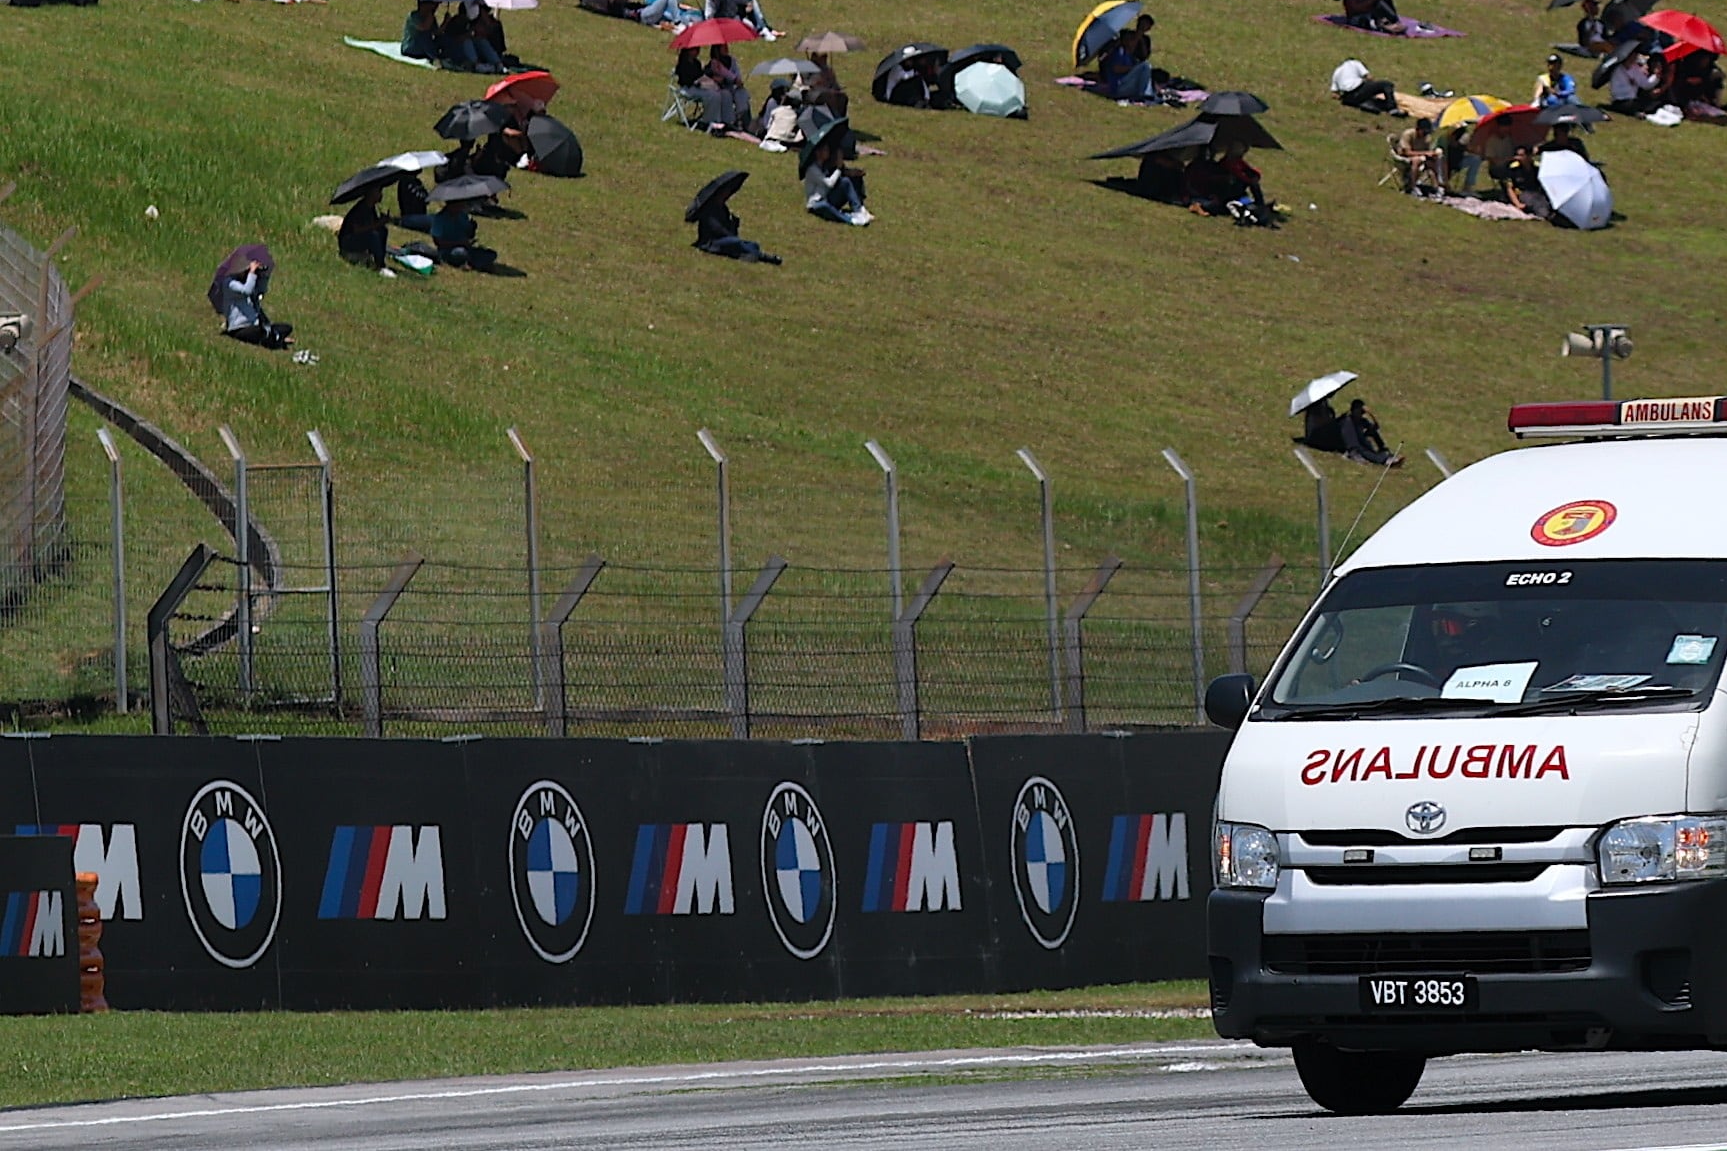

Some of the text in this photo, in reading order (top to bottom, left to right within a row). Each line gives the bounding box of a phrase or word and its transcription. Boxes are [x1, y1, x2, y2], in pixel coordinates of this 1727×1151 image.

[1624, 401, 1711, 422] AMBULANS
[1505, 571, 1572, 586] ECHO 2
[1456, 680, 1499, 689] ALPHA
[190, 791, 264, 842] BMW
[518, 790, 581, 841] BMW
[767, 792, 821, 840] BMW
[1017, 786, 1067, 833] BMW
[1370, 980, 1465, 1005] VBT 3853
